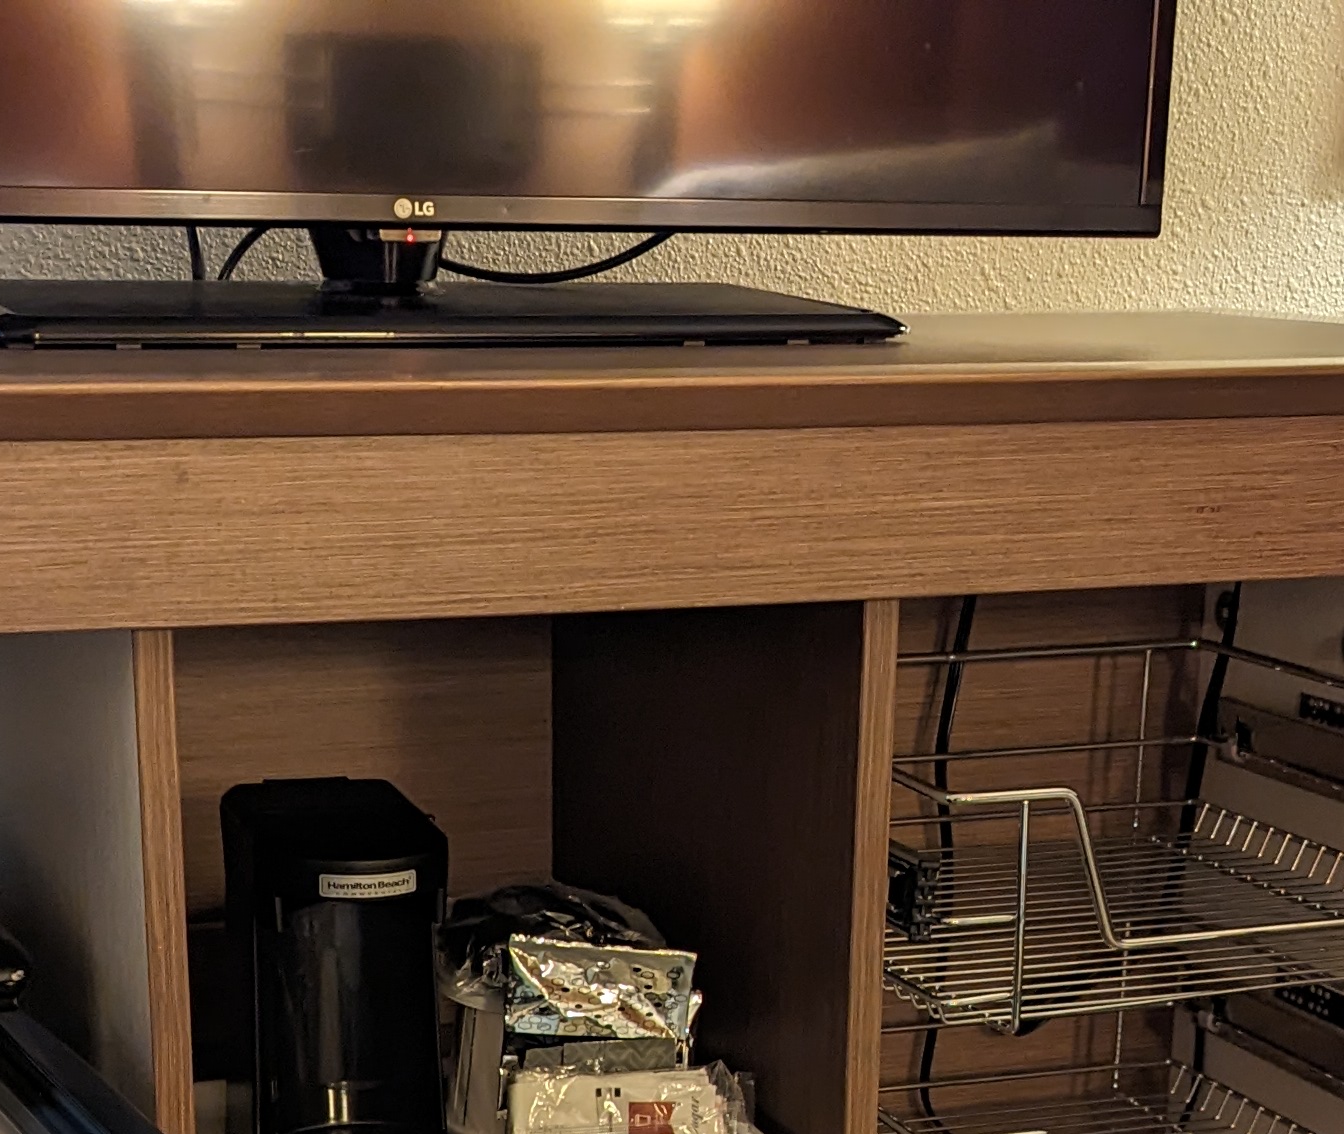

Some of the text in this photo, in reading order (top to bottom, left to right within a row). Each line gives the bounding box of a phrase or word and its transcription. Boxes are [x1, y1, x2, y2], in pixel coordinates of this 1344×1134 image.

[414, 201, 435, 216] LG
[327, 878, 410, 890] Hamilton Beach
